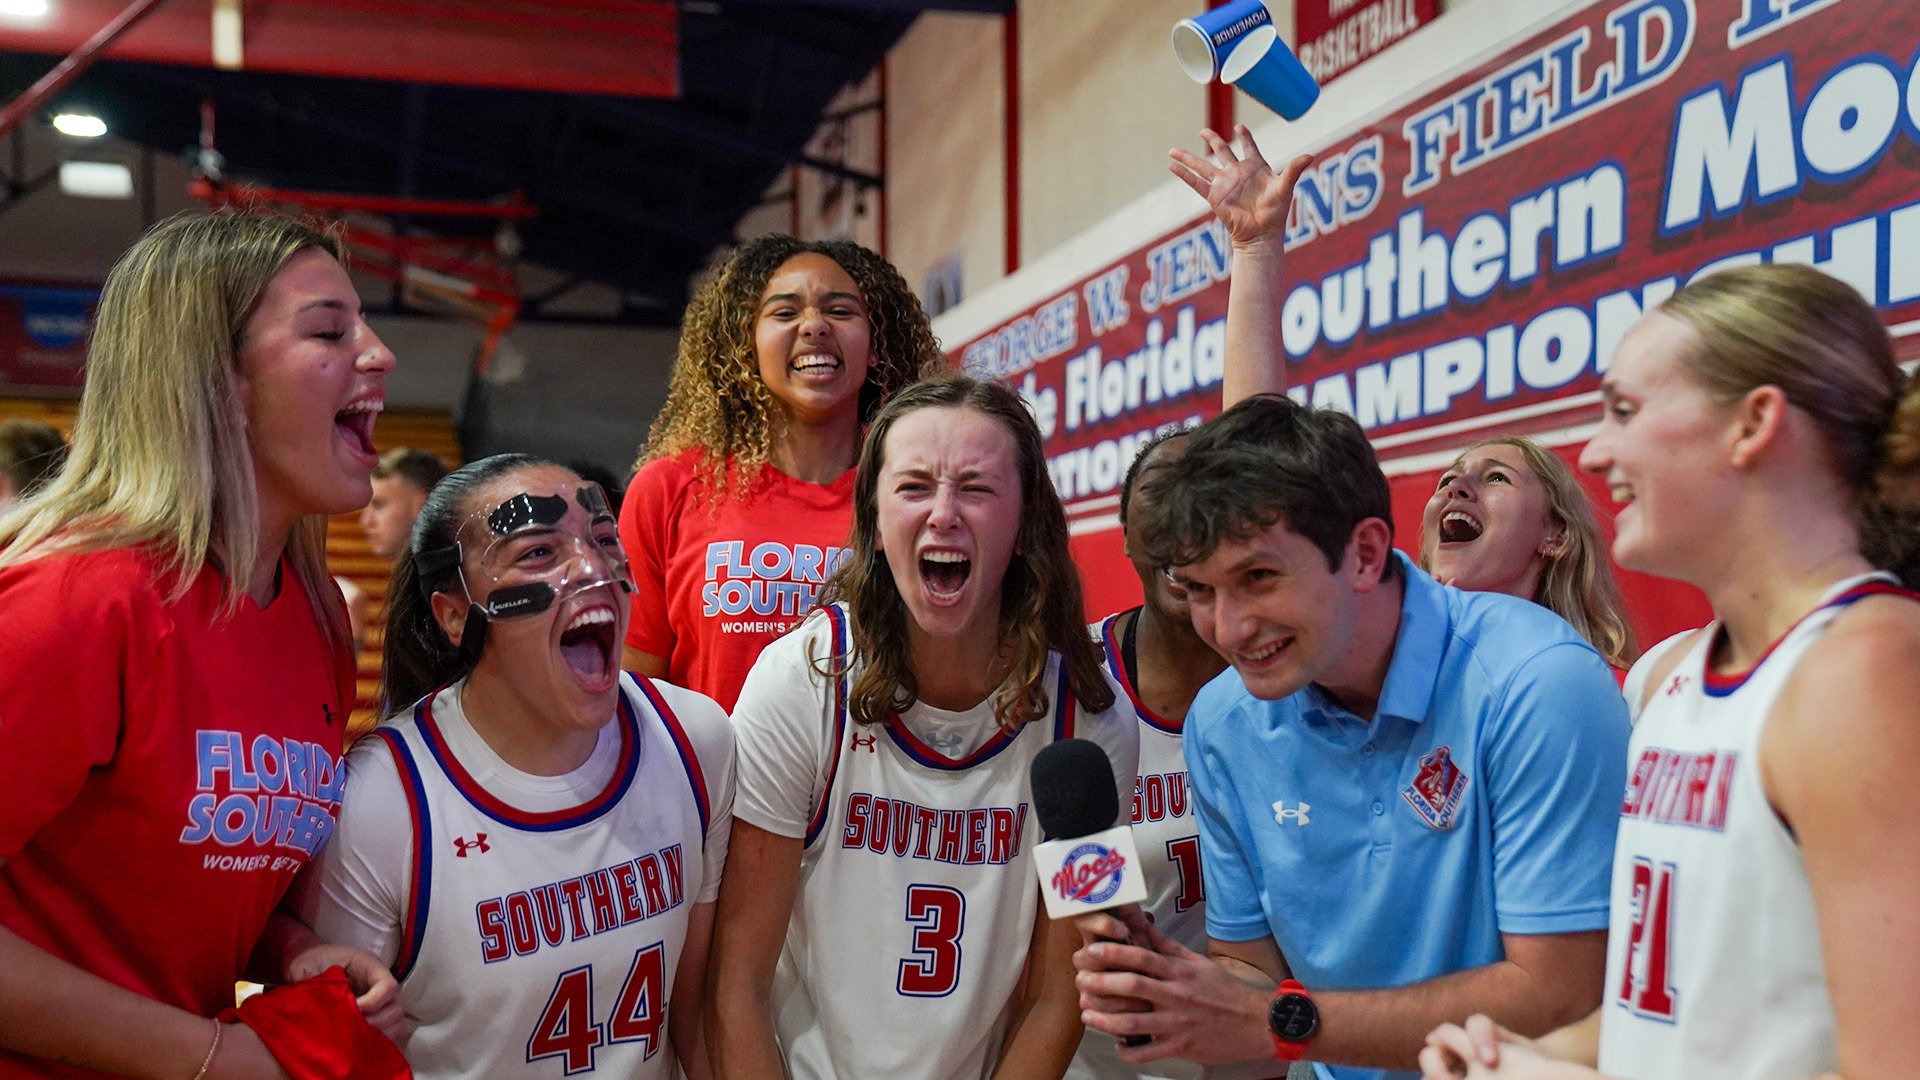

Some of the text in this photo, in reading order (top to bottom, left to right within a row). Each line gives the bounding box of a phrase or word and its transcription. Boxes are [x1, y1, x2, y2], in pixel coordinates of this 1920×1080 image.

[1213, 8, 1268, 47] POWERADE
[1140, 134, 1384, 313] JENNS
[1402, 0, 1697, 198] FIELD
[1063, 304, 1228, 433] Florida
[1281, 157, 1628, 361] outhern
[1660, 45, 1920, 238] Mo
[721, 621, 786, 634] WOMEN'S
[1405, 785, 1437, 823] FLORIDA
[476, 843, 684, 964] SOUTHERN
[1051, 846, 1126, 900] Mocs
[896, 883, 966, 998] 3
[526, 940, 668, 1077] 44
